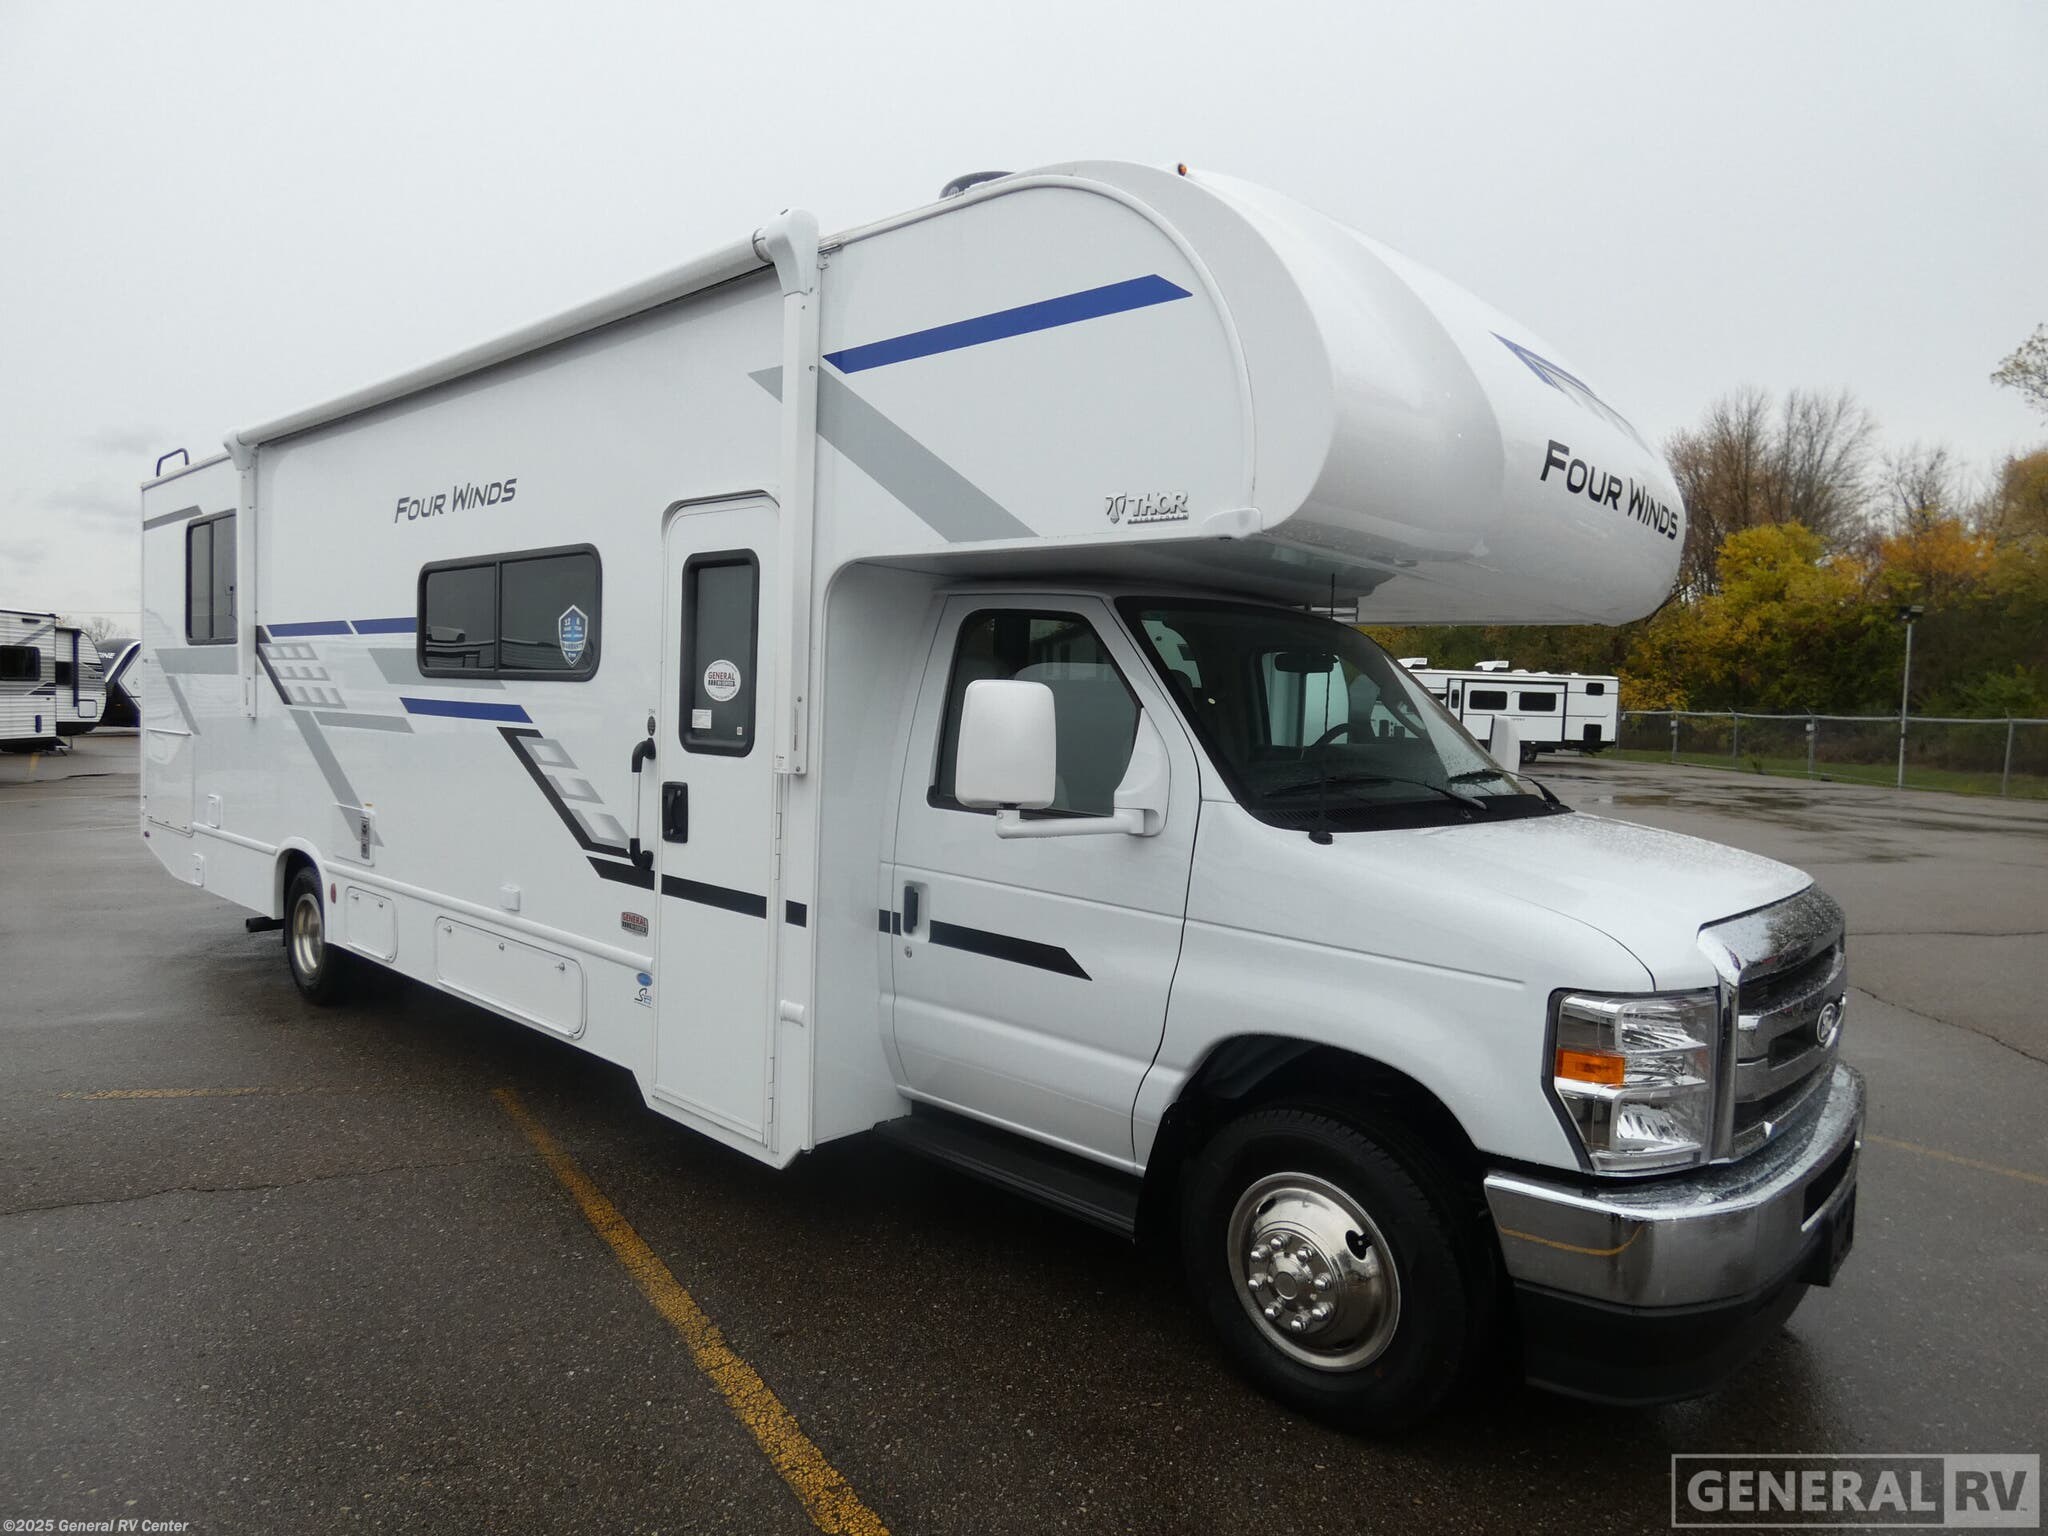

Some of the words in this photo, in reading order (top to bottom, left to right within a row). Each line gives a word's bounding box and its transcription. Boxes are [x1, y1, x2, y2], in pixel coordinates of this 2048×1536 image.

[394, 494, 447, 523] FOUR
[452, 478, 518, 512] WINDS
[1127, 491, 1188, 517] THOR
[1540, 439, 1623, 511] FOUR
[1627, 477, 1679, 541] WINDS
[707, 671, 735, 680] GENERAL
